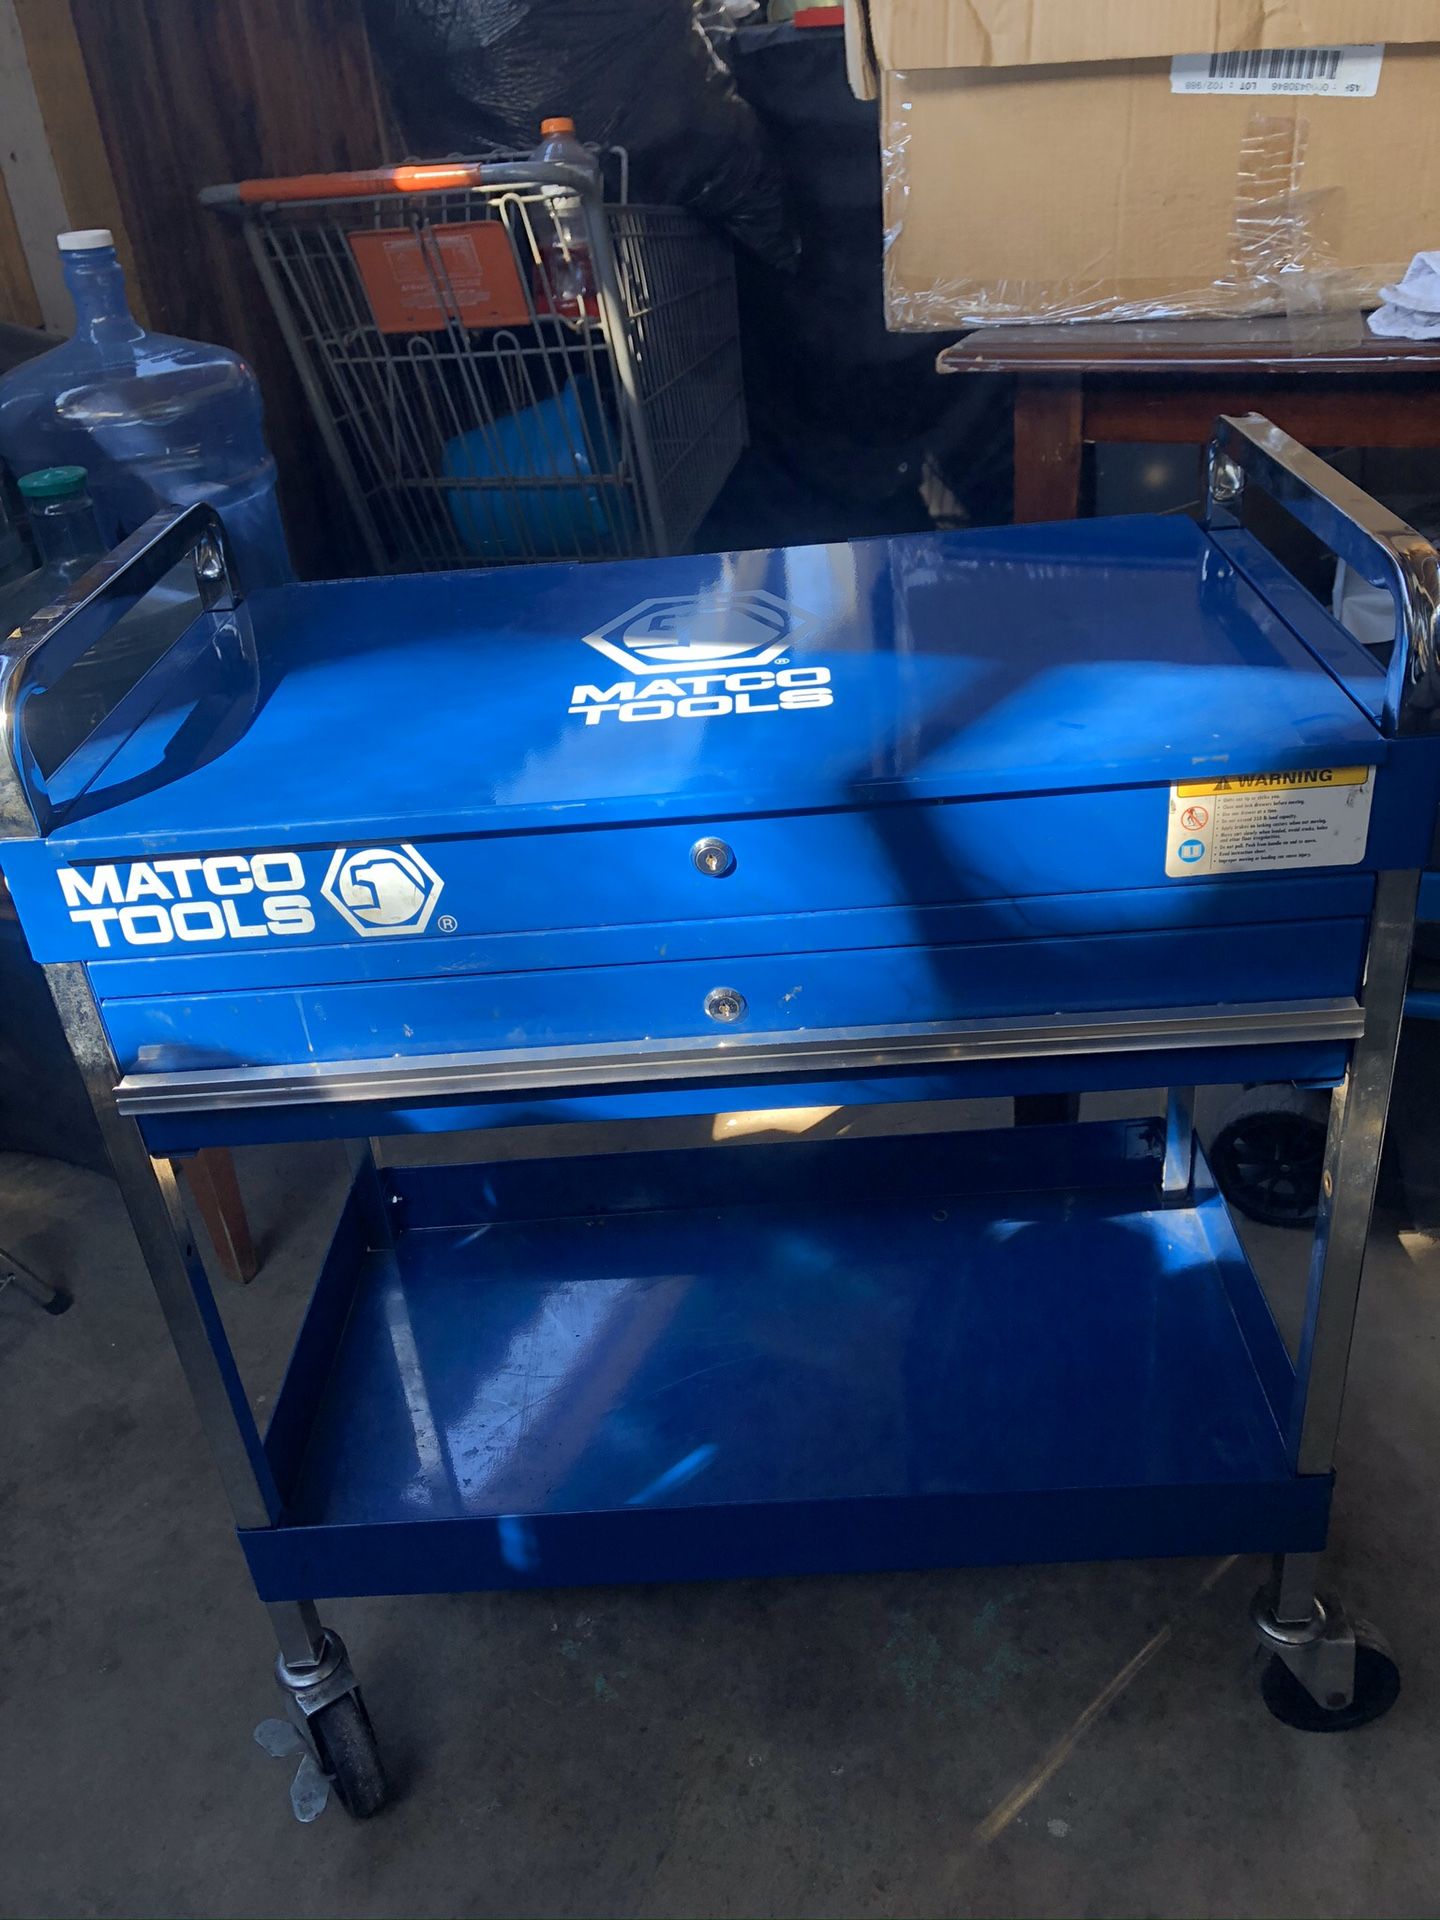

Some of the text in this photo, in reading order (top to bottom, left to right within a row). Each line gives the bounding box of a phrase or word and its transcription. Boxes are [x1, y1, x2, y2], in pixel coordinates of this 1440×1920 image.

[1239, 81, 1257, 91] LOT
[571, 666, 832, 704] MATCO
[567, 687, 834, 726] TOOLS
[1238, 768, 1333, 788] WARNING
[56, 852, 306, 907] MATCO
[69, 894, 316, 948] TOOLS
